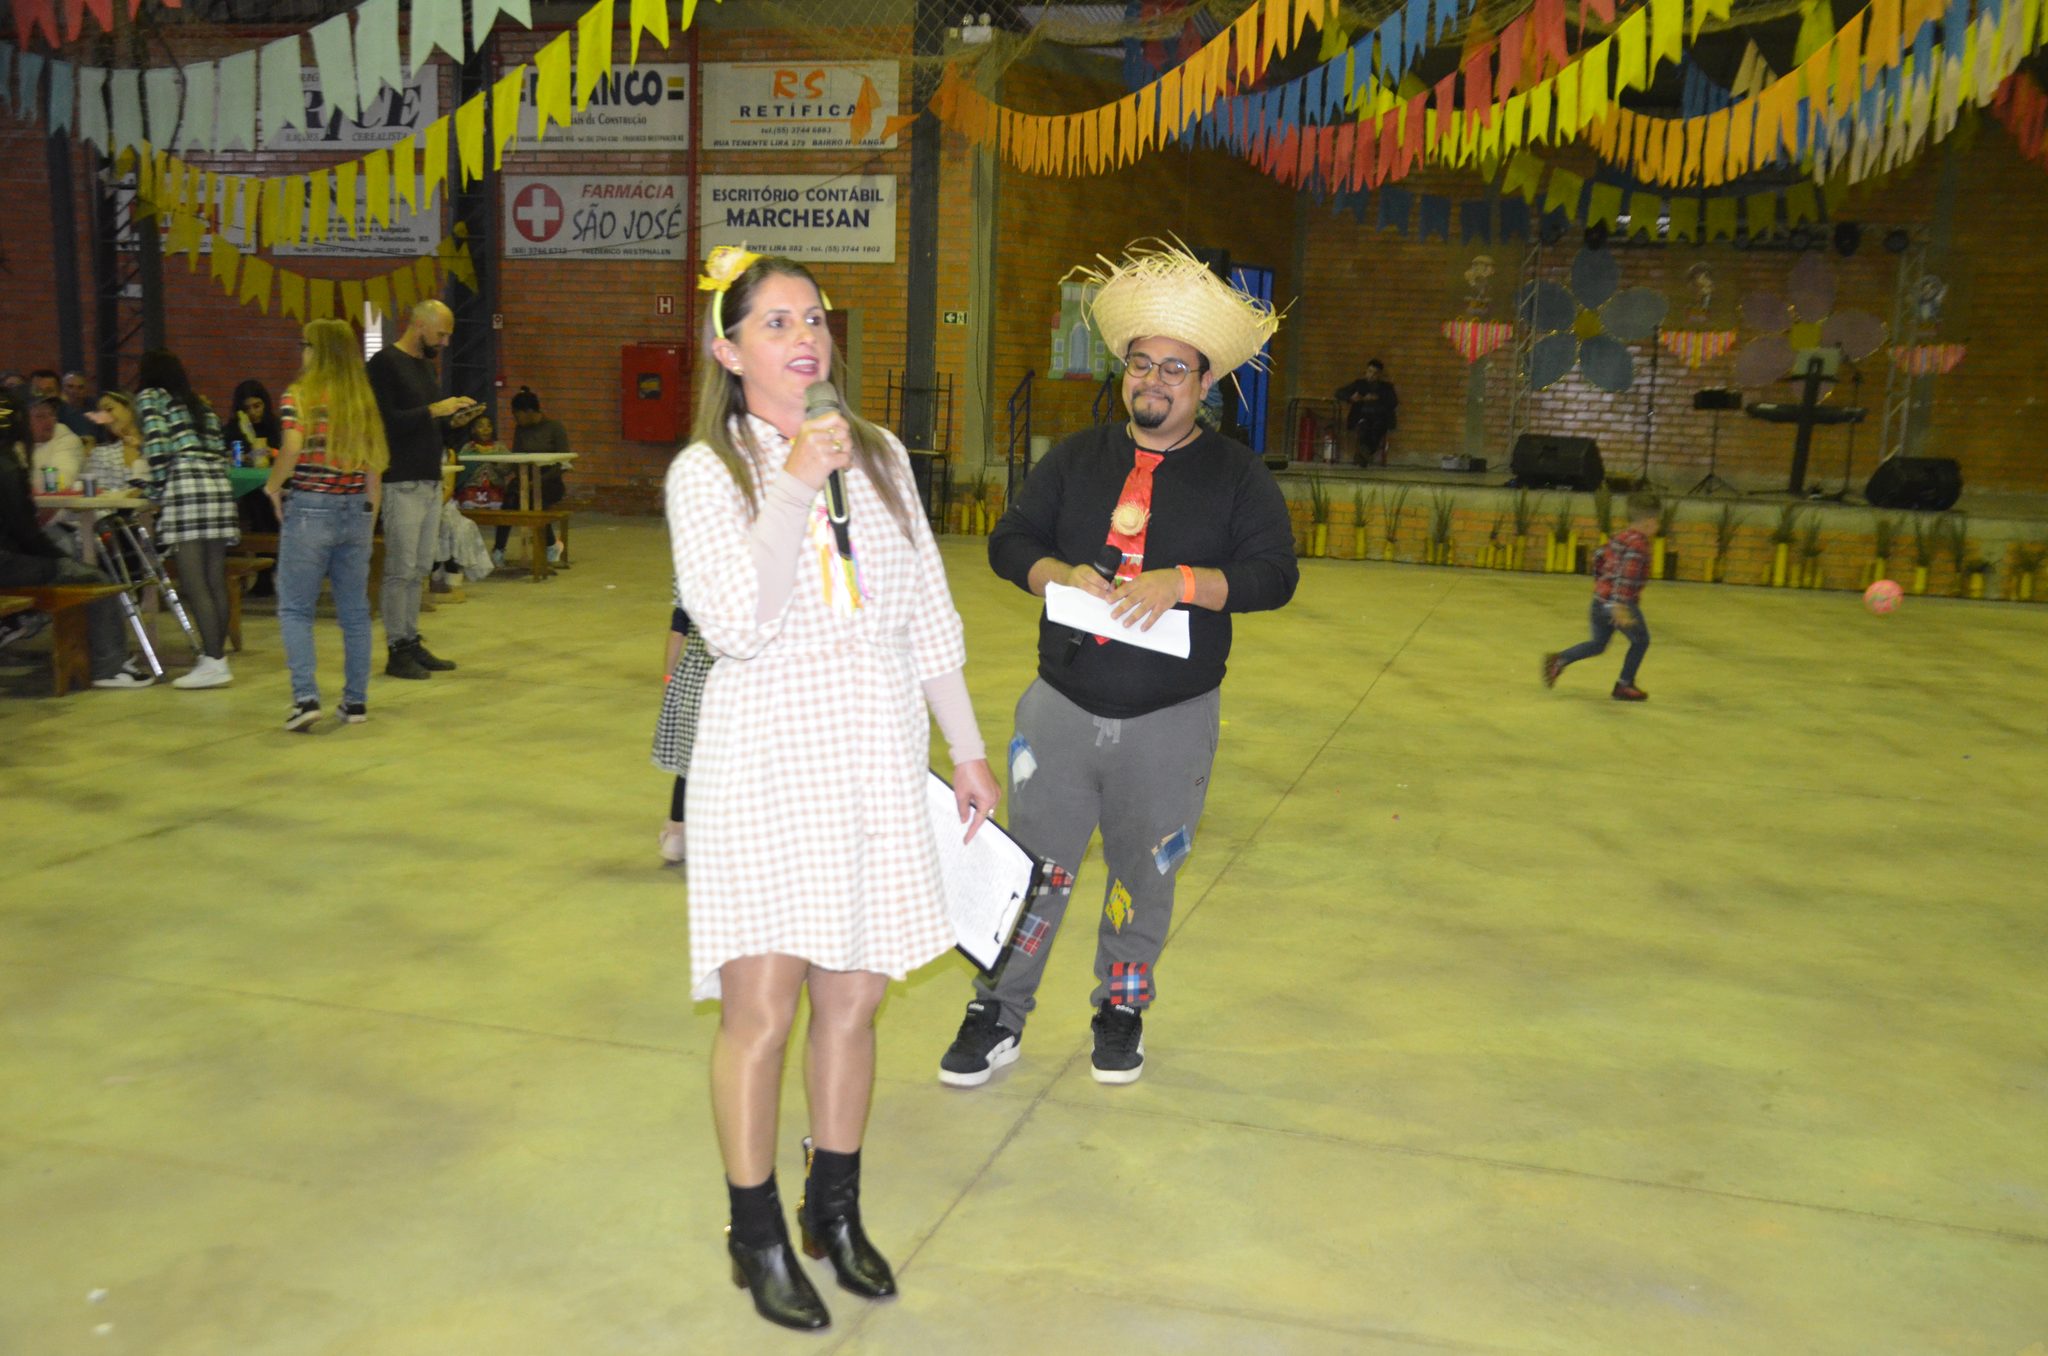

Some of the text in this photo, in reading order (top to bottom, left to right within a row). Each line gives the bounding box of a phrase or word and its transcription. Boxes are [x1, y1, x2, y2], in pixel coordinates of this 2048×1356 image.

[772, 69, 827, 99] RS
[739, 102, 857, 118] RETÍFICA
[731, 139, 768, 147] TENENTE
[770, 139, 789, 147] LIRA
[581, 180, 674, 199] FARMÁCIA
[712, 184, 885, 202] ESCRITÓRIO CONTÁBIL
[572, 202, 683, 241] SÃO JOSÉ
[726, 207, 871, 229] MARCHESAN
[769, 244, 788, 252] LIRA
